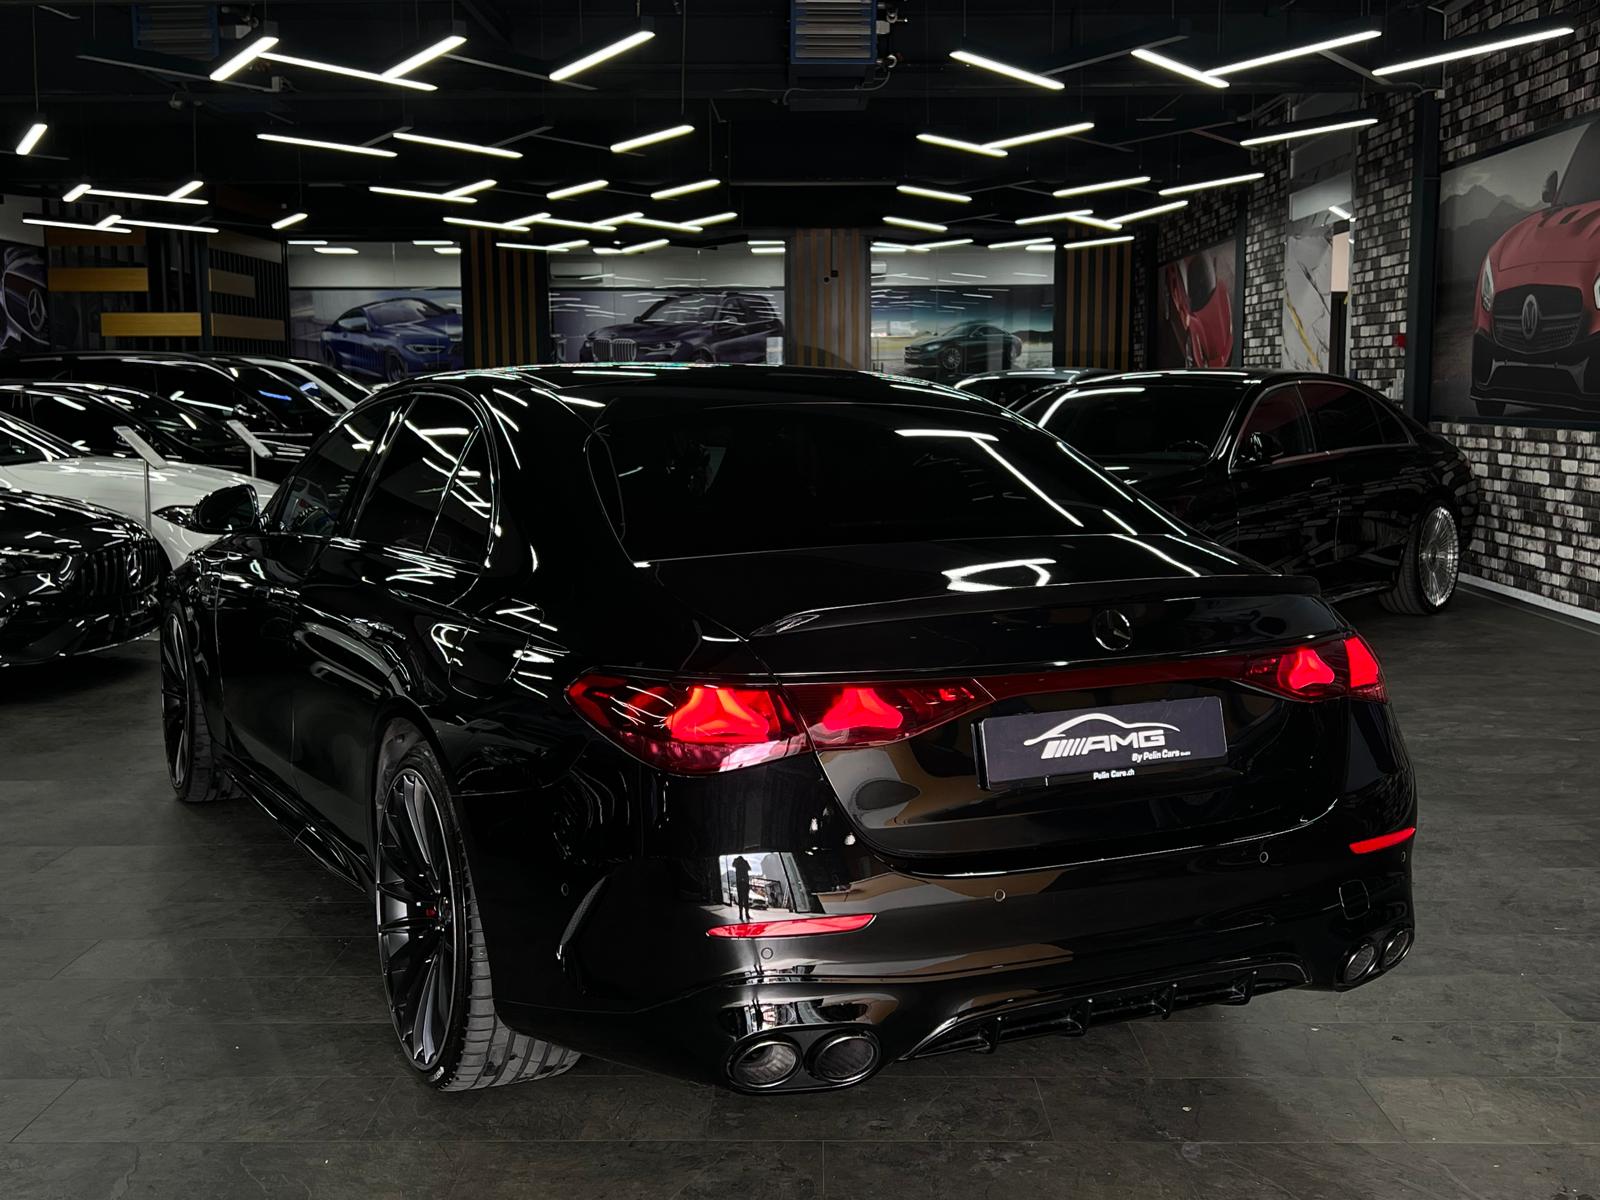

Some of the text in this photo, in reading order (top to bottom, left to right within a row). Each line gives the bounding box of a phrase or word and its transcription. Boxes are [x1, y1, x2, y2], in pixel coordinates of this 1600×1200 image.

[1080, 729, 1166, 755] AMG
[1131, 752, 1143, 764] By
[1162, 749, 1180, 758] Cars
